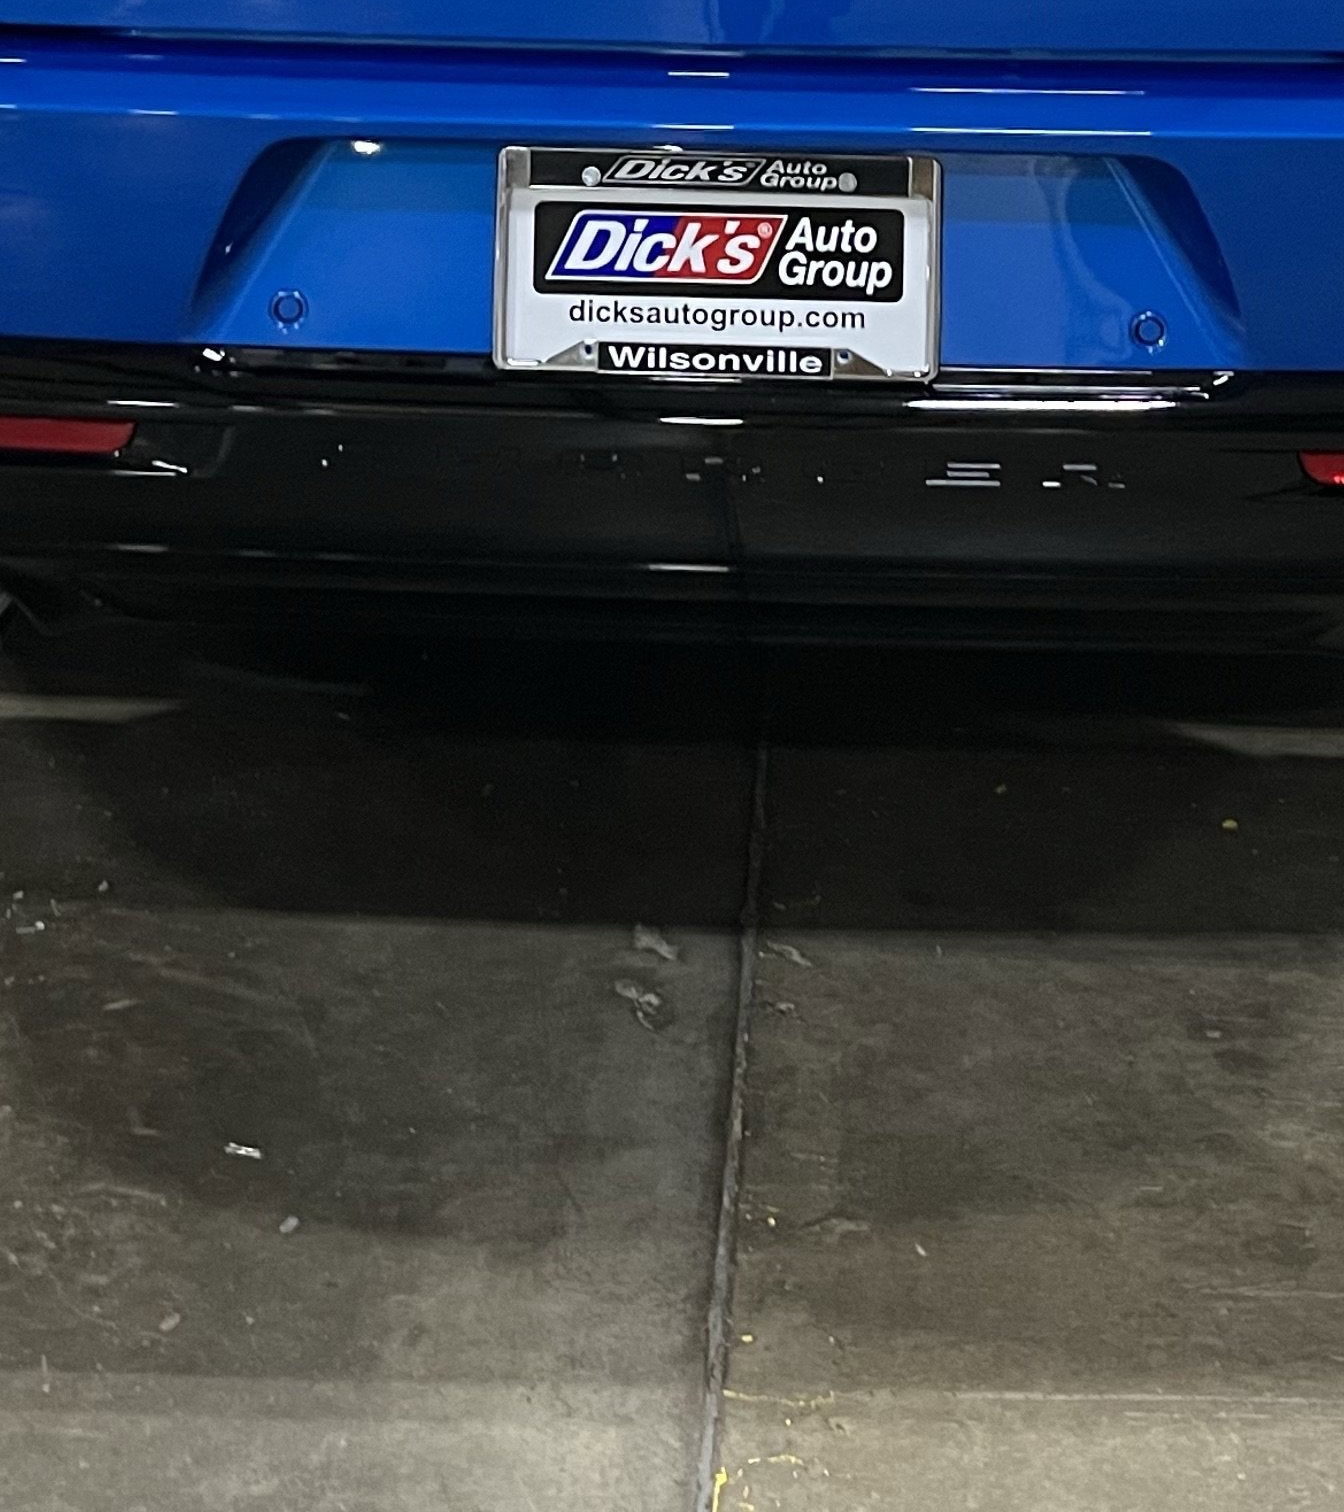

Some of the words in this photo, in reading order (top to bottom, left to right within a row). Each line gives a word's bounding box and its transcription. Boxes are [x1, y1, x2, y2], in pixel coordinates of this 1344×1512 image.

[613, 158, 748, 182] Dick's
[759, 172, 838, 192] Group
[765, 159, 828, 175] Auto
[564, 218, 761, 274] Dick's
[784, 216, 878, 254] Auto
[778, 252, 893, 295] Group
[568, 299, 866, 333] dicksautogroup.com
[606, 345, 823, 374] Wilsonville
